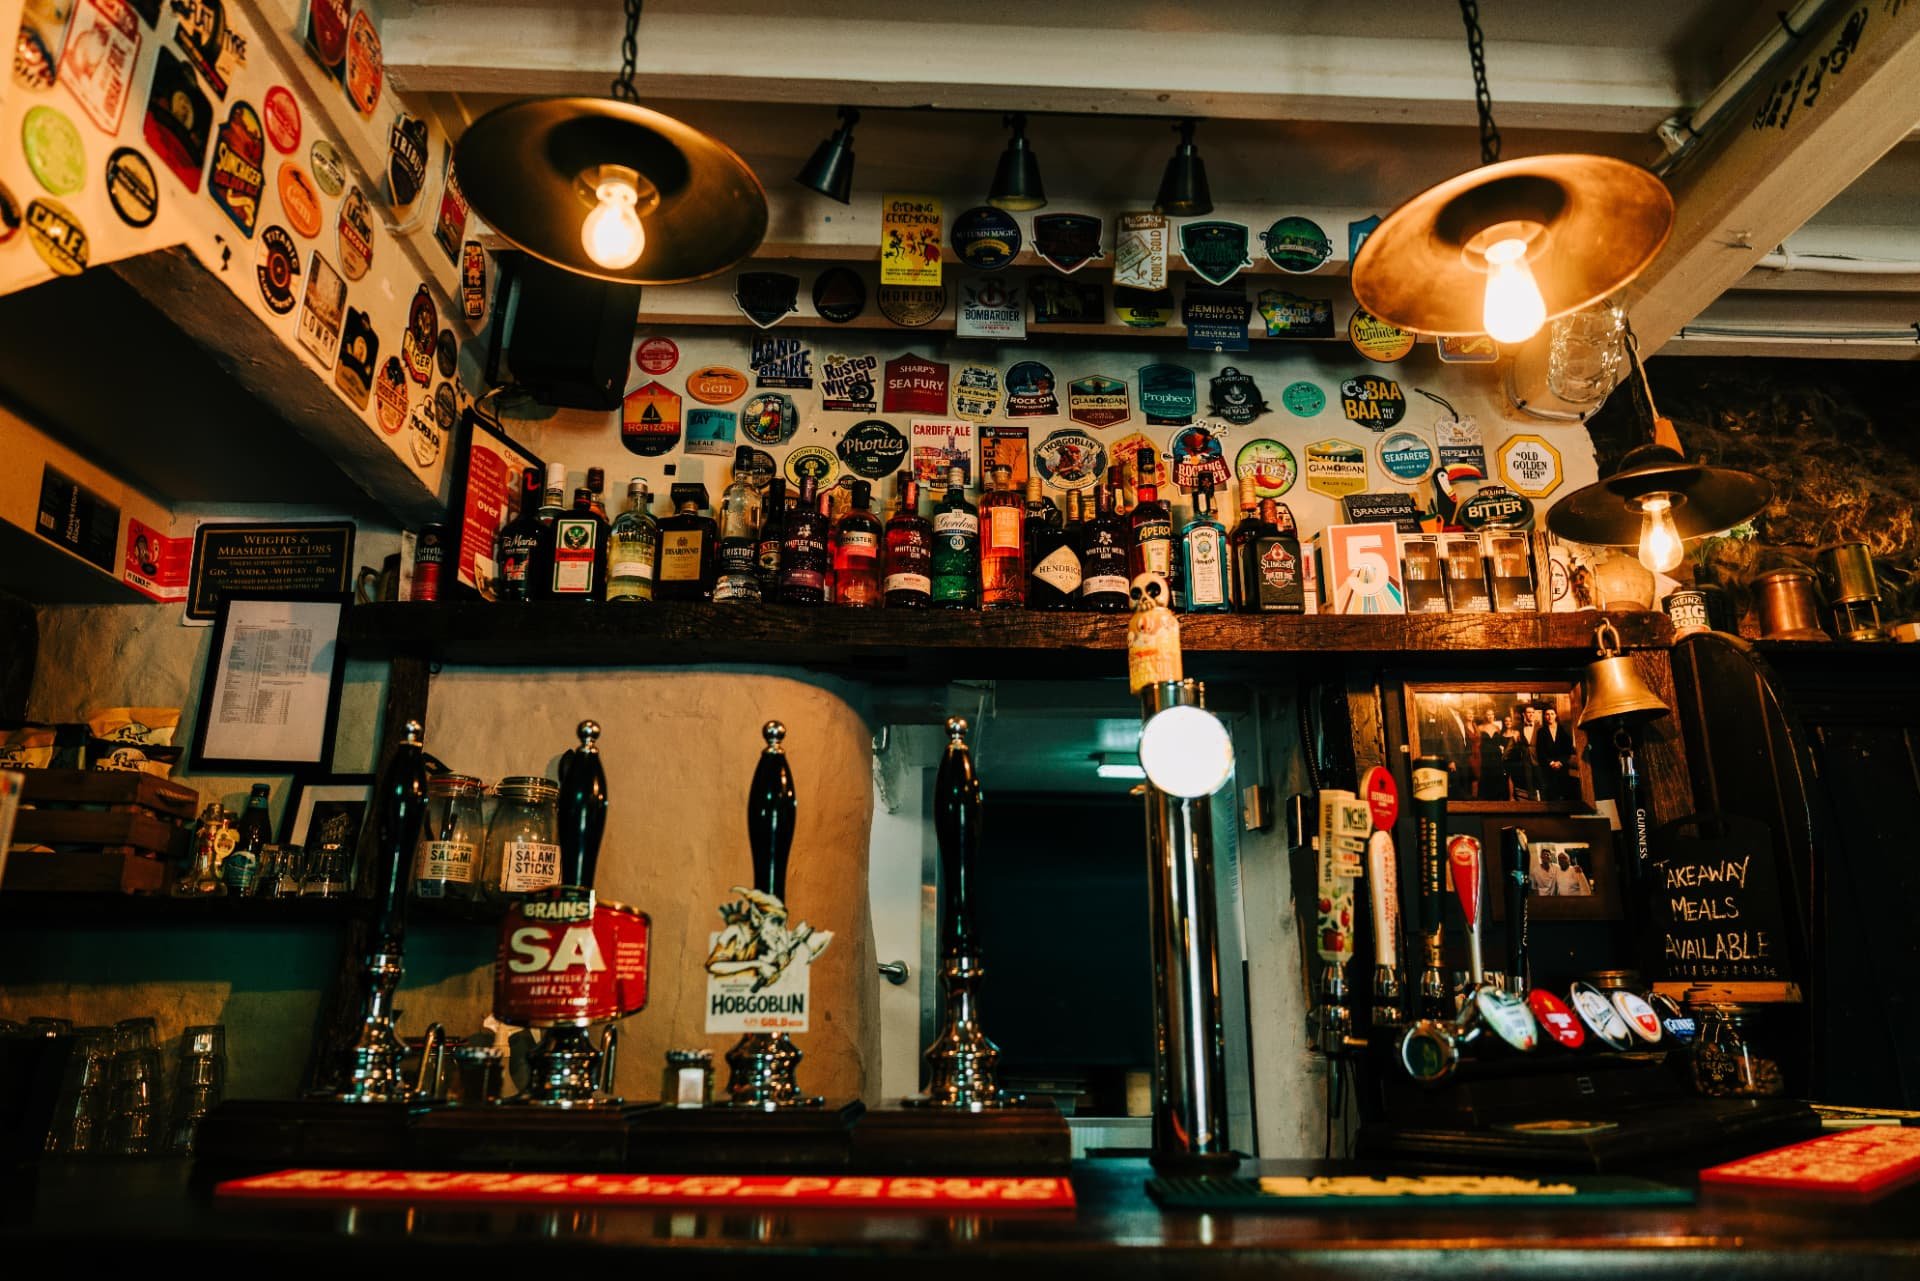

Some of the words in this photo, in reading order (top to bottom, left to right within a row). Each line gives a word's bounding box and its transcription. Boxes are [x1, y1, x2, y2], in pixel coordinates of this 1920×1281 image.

[886, 214, 939, 224] CEREMONY
[266, 230, 299, 268] TITANIC
[964, 308, 1020, 321] BOMBARDIER
[1189, 304, 1245, 313] JEMIMA'S
[1274, 308, 1310, 317] SOUTH
[303, 313, 337, 353] LOWRY
[1354, 326, 1396, 342] Summer
[760, 350, 811, 378] BRAKE
[899, 365, 936, 375] SHARP'S
[700, 382, 734, 395] Gem
[889, 379, 911, 389] SEA
[914, 380, 944, 391] FURY
[1366, 381, 1402, 400] BAA
[1009, 397, 1037, 405] ROCK
[1144, 393, 1193, 405] Prophecy
[1345, 400, 1381, 420] BAA
[628, 423, 674, 432] HORIZON
[913, 425, 952, 437] CARDIFF
[954, 426, 971, 437] ALE
[842, 438, 905, 454] Phonics
[1044, 437, 1095, 453] HOBGOBLIN
[1384, 452, 1430, 463] SEAFARERS
[1309, 464, 1364, 474] GLAMORGAN
[1513, 461, 1547, 471] GOLDEN
[478, 500, 498, 518] over
[1352, 506, 1412, 518] BRAKSPEAR
[1468, 501, 1522, 518] BITTER
[243, 535, 296, 545] WEIGHTS
[299, 535, 310, 544] &
[217, 545, 277, 556] MEASURES
[279, 545, 303, 555] ACT
[306, 544, 332, 554] 1985
[316, 567, 336, 575] RUM
[1670, 604, 1706, 622] BIG
[1672, 619, 1706, 629] SOUP
[1636, 808, 1648, 860] GUINNESS
[430, 850, 471, 863] SALAMI
[516, 851, 556, 863] SALAMI
[515, 863, 555, 876] STICKS
[1653, 855, 1749, 889] TAKEAWAY
[524, 901, 590, 919] BRAINS
[1671, 896, 1739, 921] MEALS
[507, 926, 607, 974] SA
[1665, 931, 1768, 960] AVAILABLE
[711, 994, 805, 1015] HOBGOBLIN
